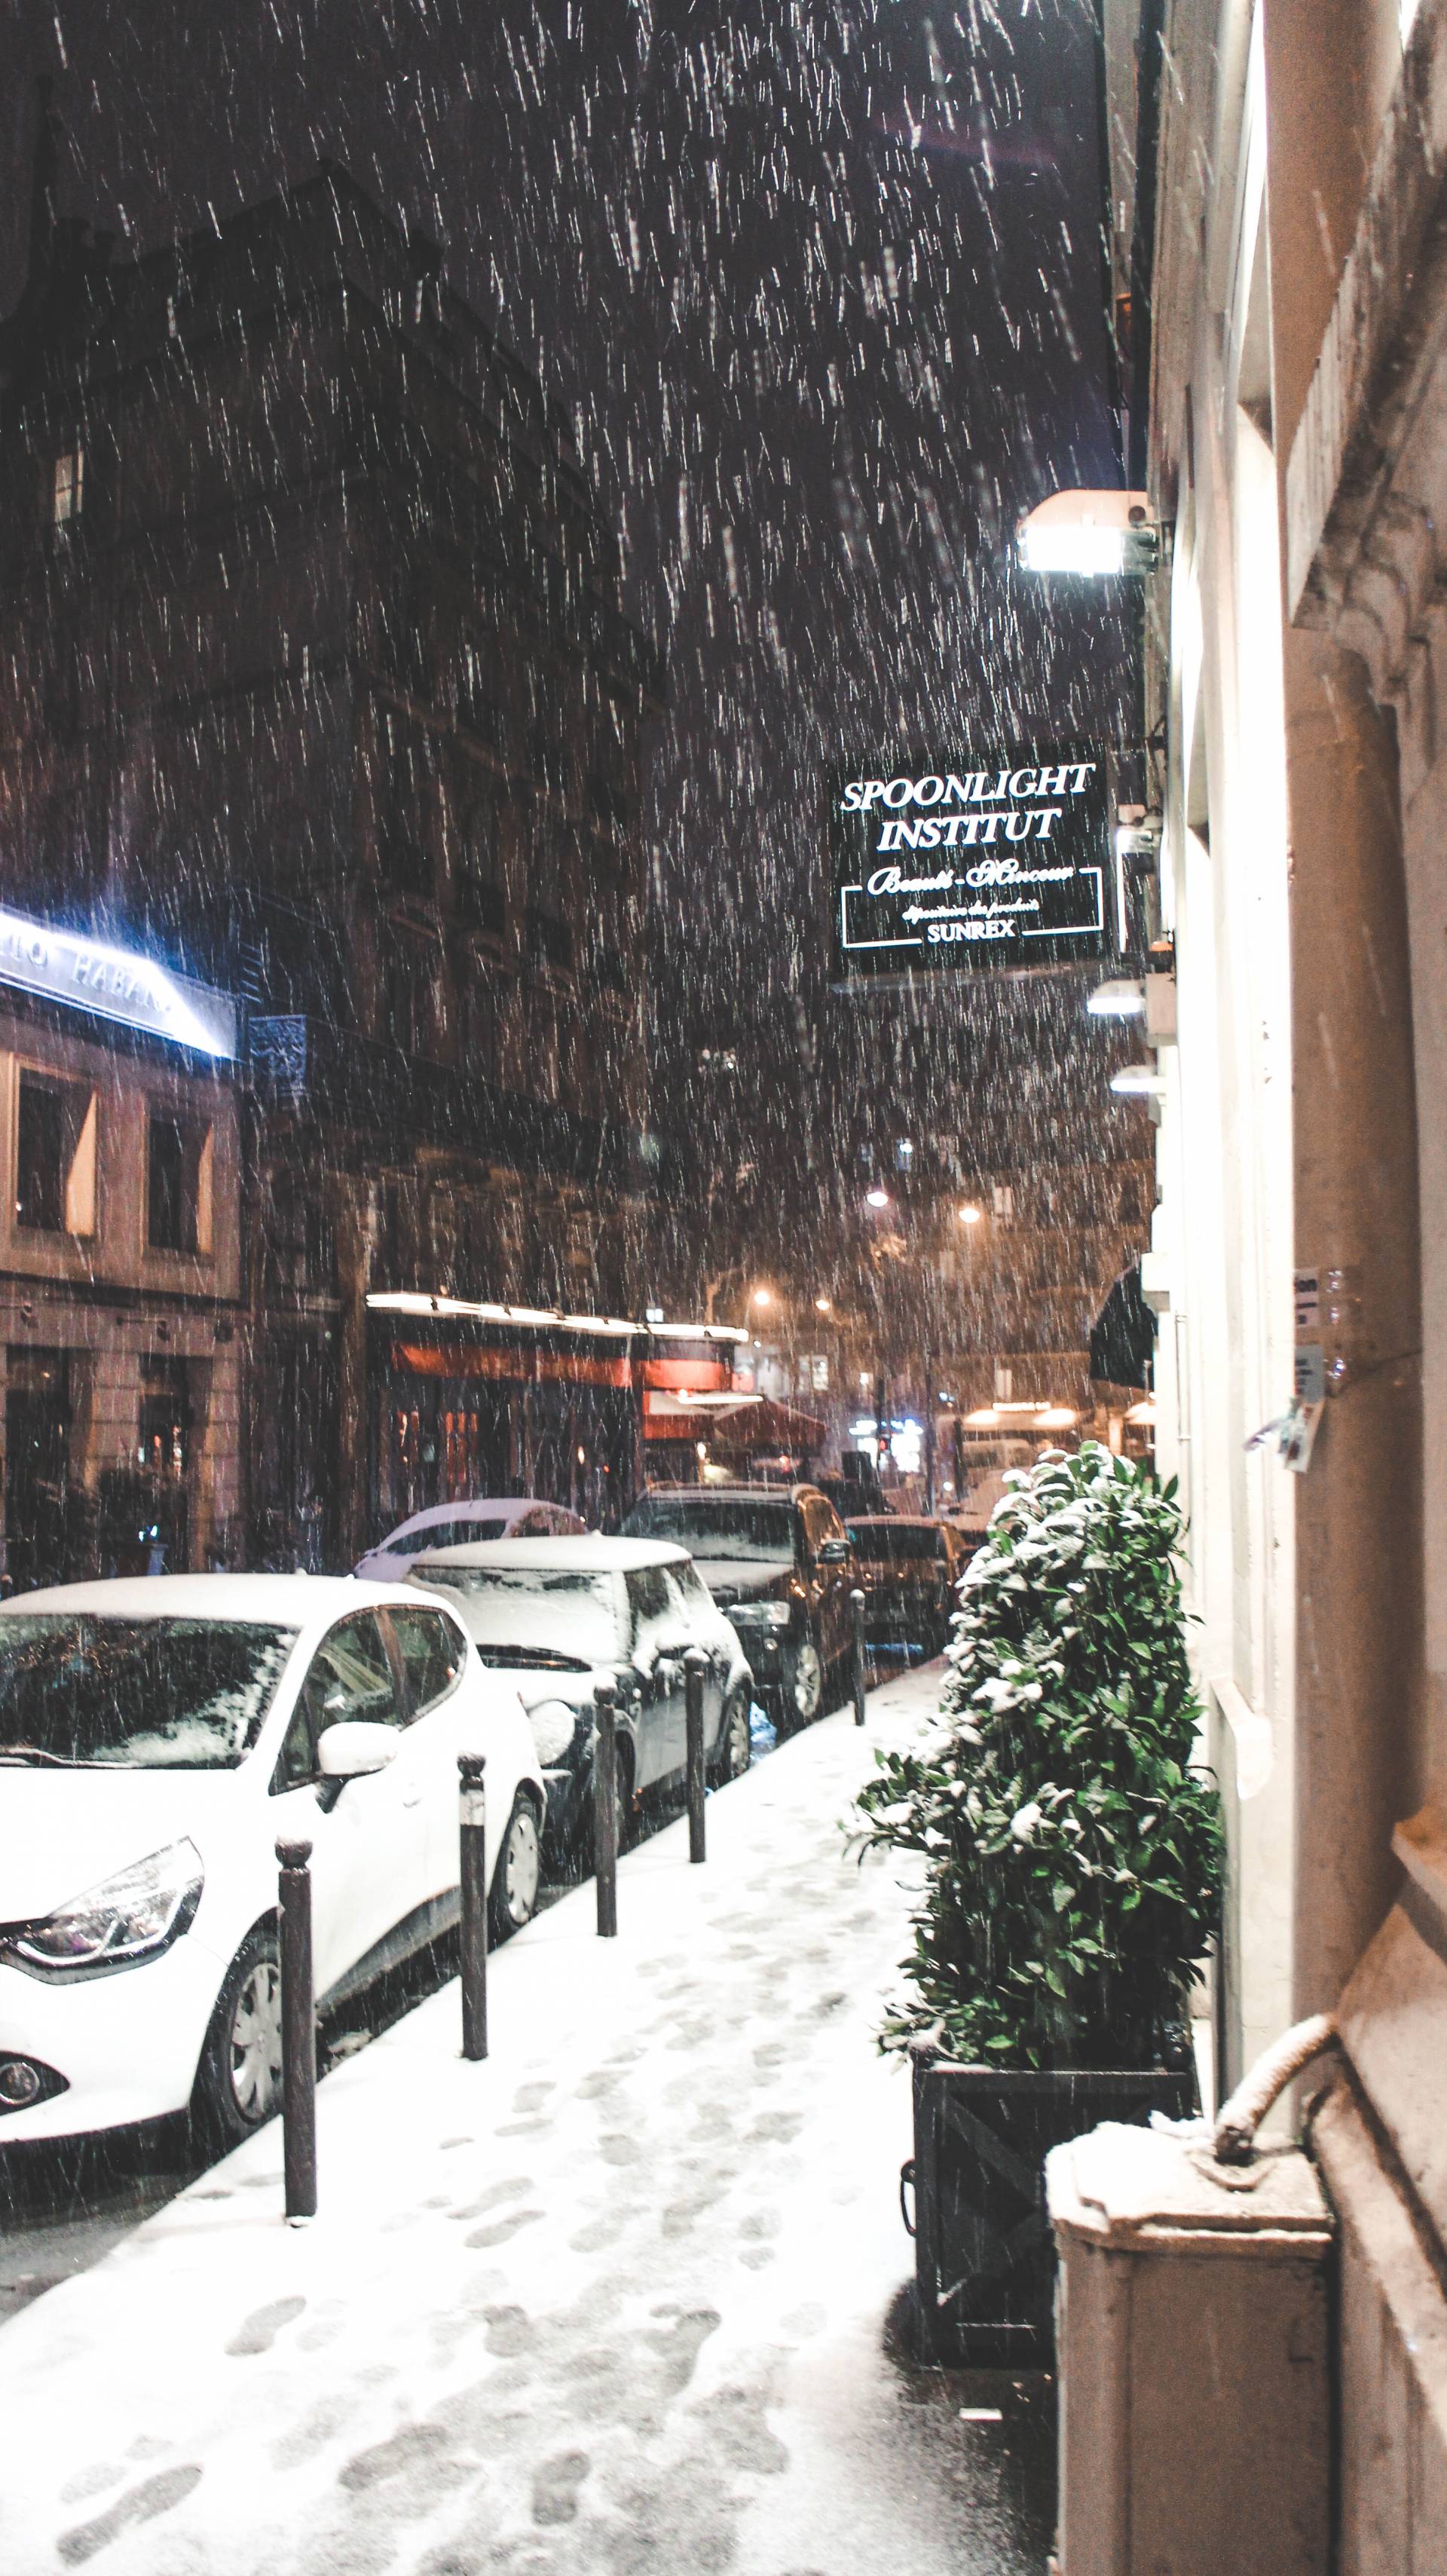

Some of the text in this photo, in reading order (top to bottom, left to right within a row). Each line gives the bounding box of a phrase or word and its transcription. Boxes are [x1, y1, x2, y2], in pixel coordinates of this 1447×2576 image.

[840, 762, 1097, 812] SPOONLIGHT
[876, 807, 1063, 852] INSTITUT
[927, 919, 1015, 944] SUNREX
